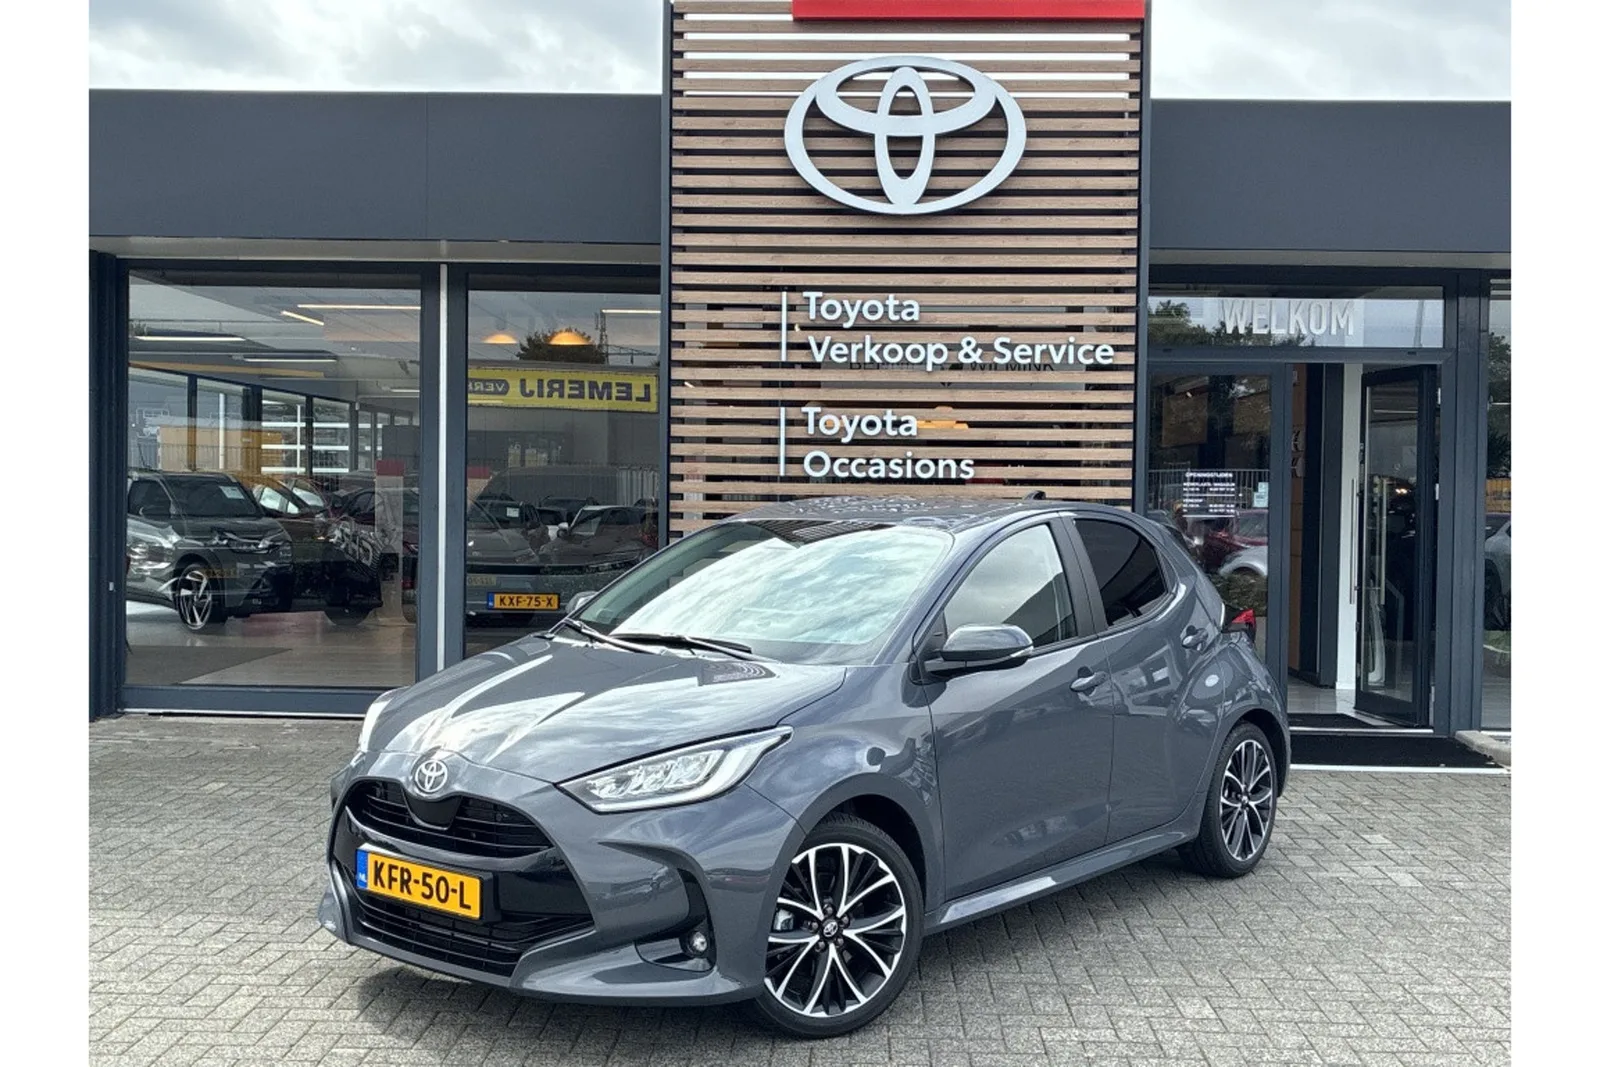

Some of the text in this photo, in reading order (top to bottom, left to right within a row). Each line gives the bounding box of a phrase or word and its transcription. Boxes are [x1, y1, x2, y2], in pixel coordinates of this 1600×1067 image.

[802, 292, 920, 329] Toyota
[1221, 299, 1354, 336] WELKOM
[807, 334, 1115, 372] Verkoop & Service
[801, 407, 918, 443] Toyota
[803, 450, 975, 479] Occasions
[499, 595, 553, 607] KXF-75-X
[373, 860, 471, 910] KFR-50-L
